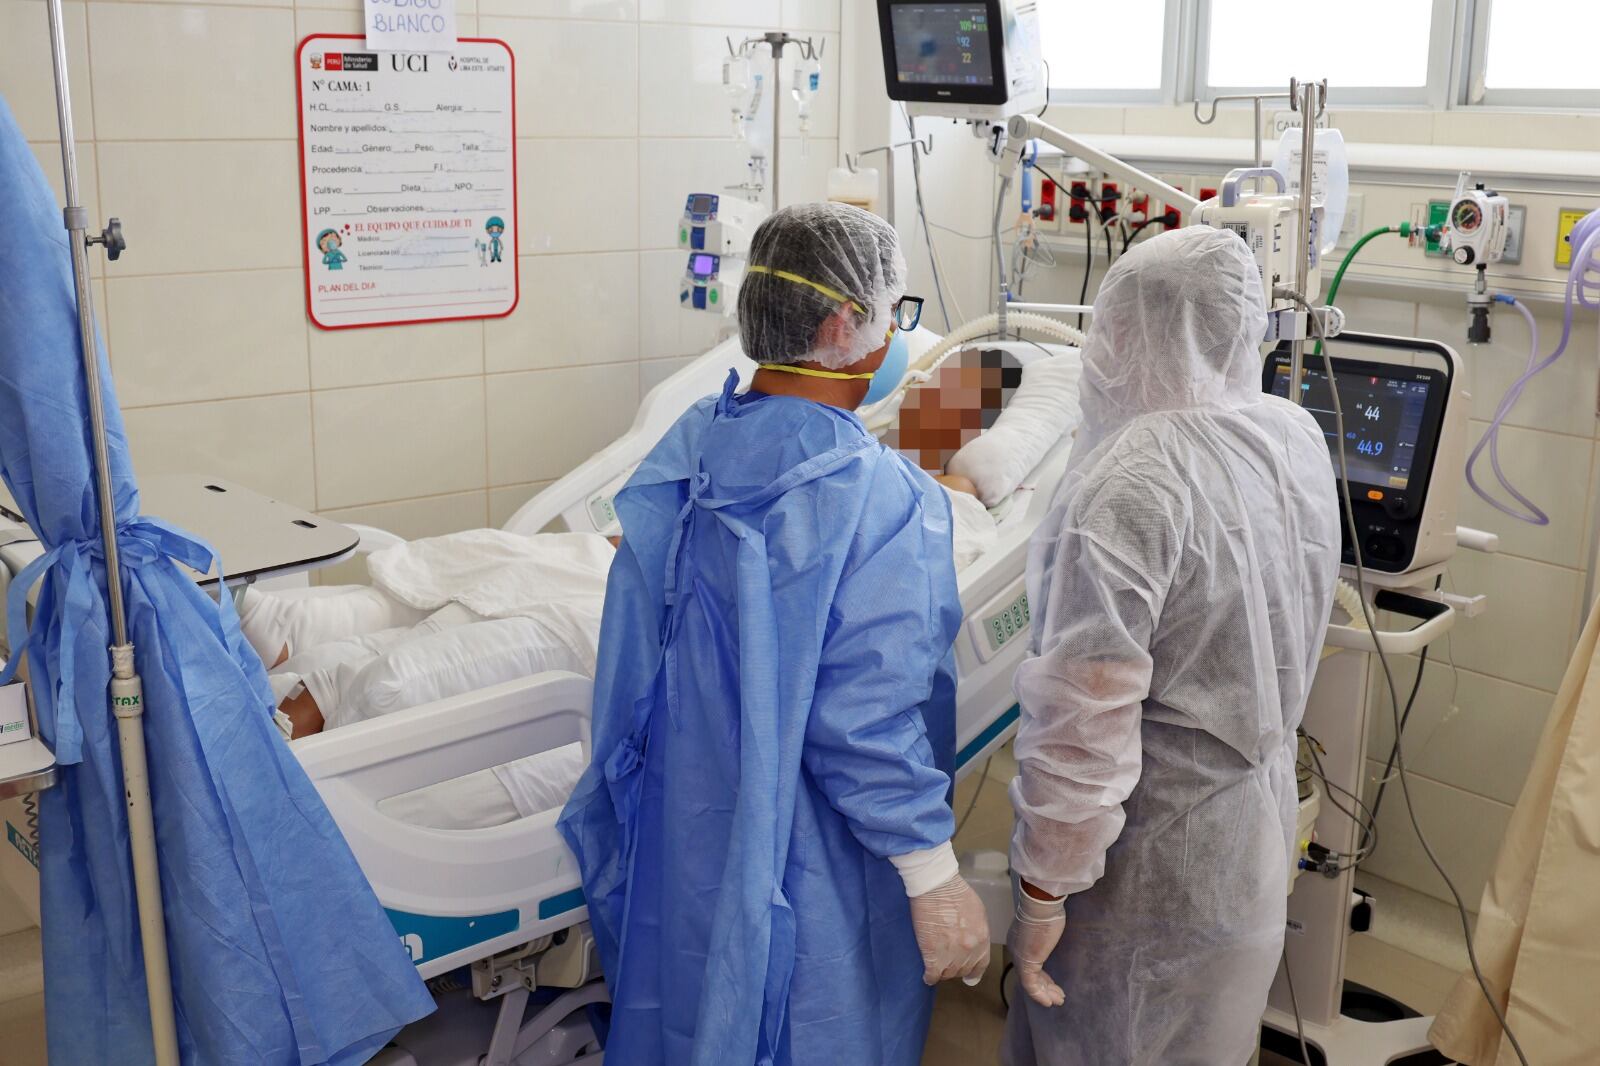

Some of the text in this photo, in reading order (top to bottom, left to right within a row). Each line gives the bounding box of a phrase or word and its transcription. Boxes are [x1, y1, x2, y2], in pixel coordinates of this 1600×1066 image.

[373, 13, 445, 32] BLANCO
[390, 53, 428, 72] UCI
[962, 52, 972, 63] 22
[328, 81, 362, 91] CAMA:
[366, 81, 371, 91] 1
[310, 124, 342, 132] Nombre
[344, 125, 350, 134] y
[355, 218, 472, 232] EL EQUIPO QUE CUIDA DE TI
[318, 284, 341, 292] PLAN
[343, 282, 359, 291] DEL
[1364, 405, 1380, 421] 44
[1356, 440, 1383, 456] 44.9
[112, 695, 140, 706] TAX
